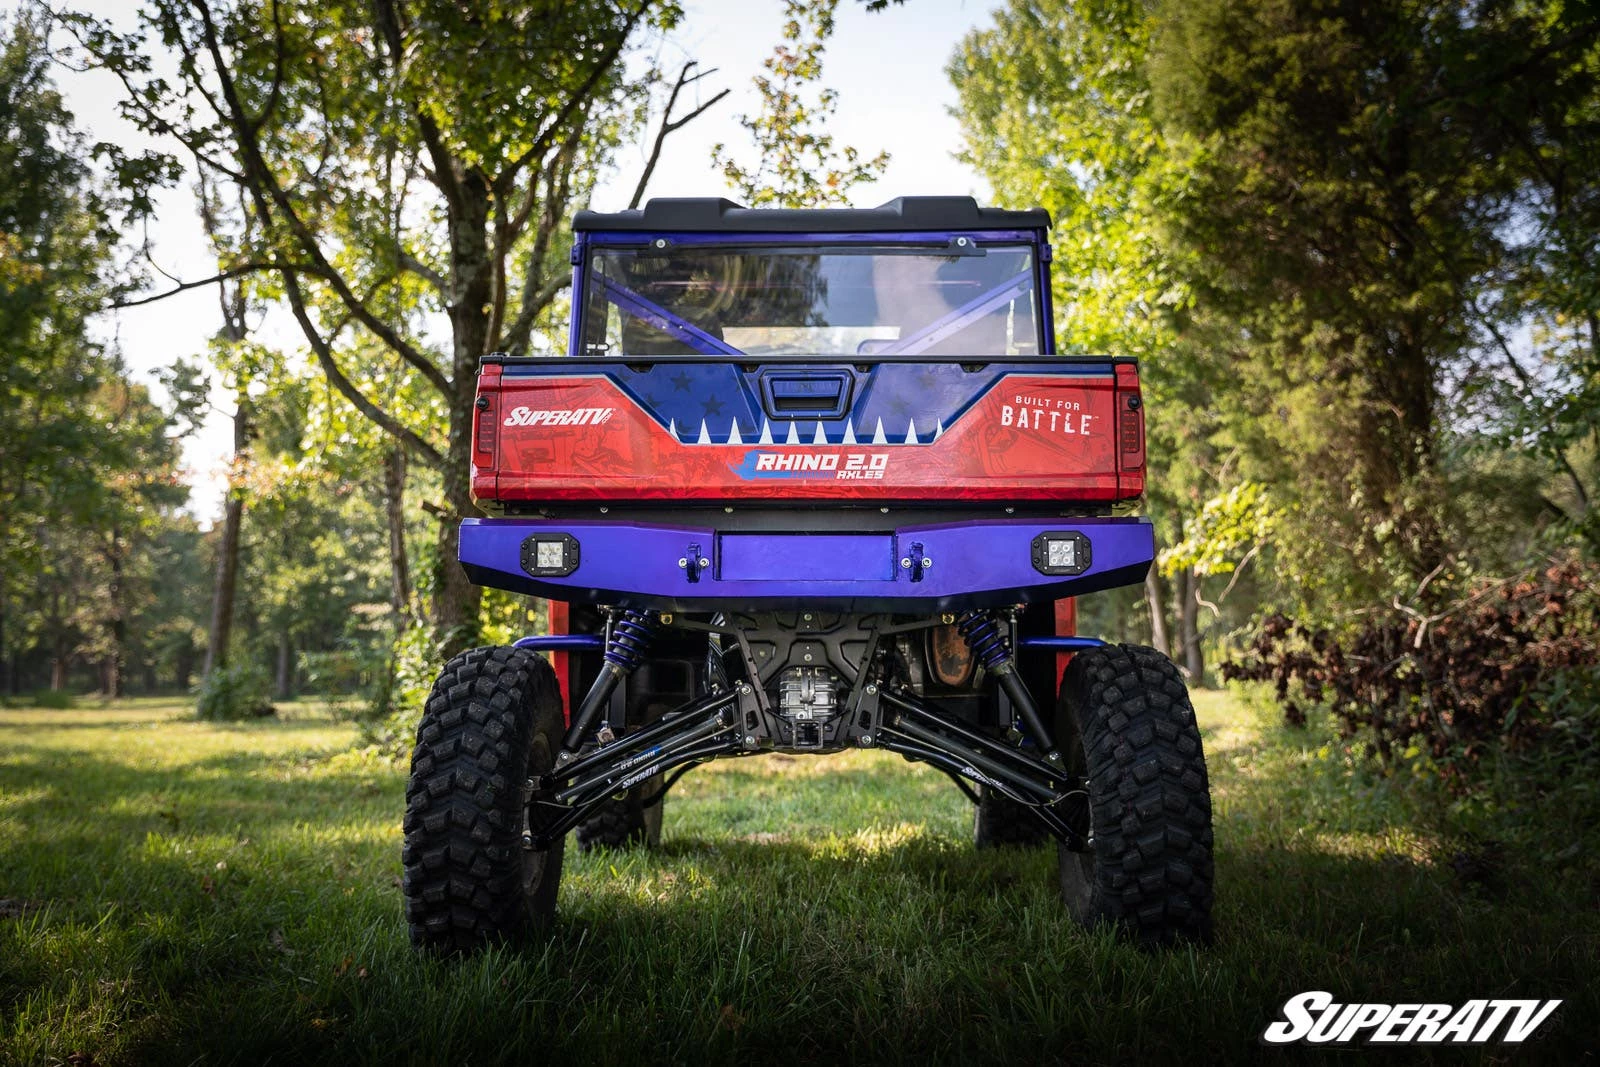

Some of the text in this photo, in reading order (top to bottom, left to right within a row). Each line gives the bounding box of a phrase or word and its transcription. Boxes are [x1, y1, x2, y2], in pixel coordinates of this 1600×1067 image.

[1015, 395, 1081, 411] BUILT FOR
[503, 405, 610, 427] SUPERATV
[1001, 405, 1093, 436] BATTLE
[756, 453, 889, 471] RHINO 2.0
[836, 470, 885, 480] AXLES
